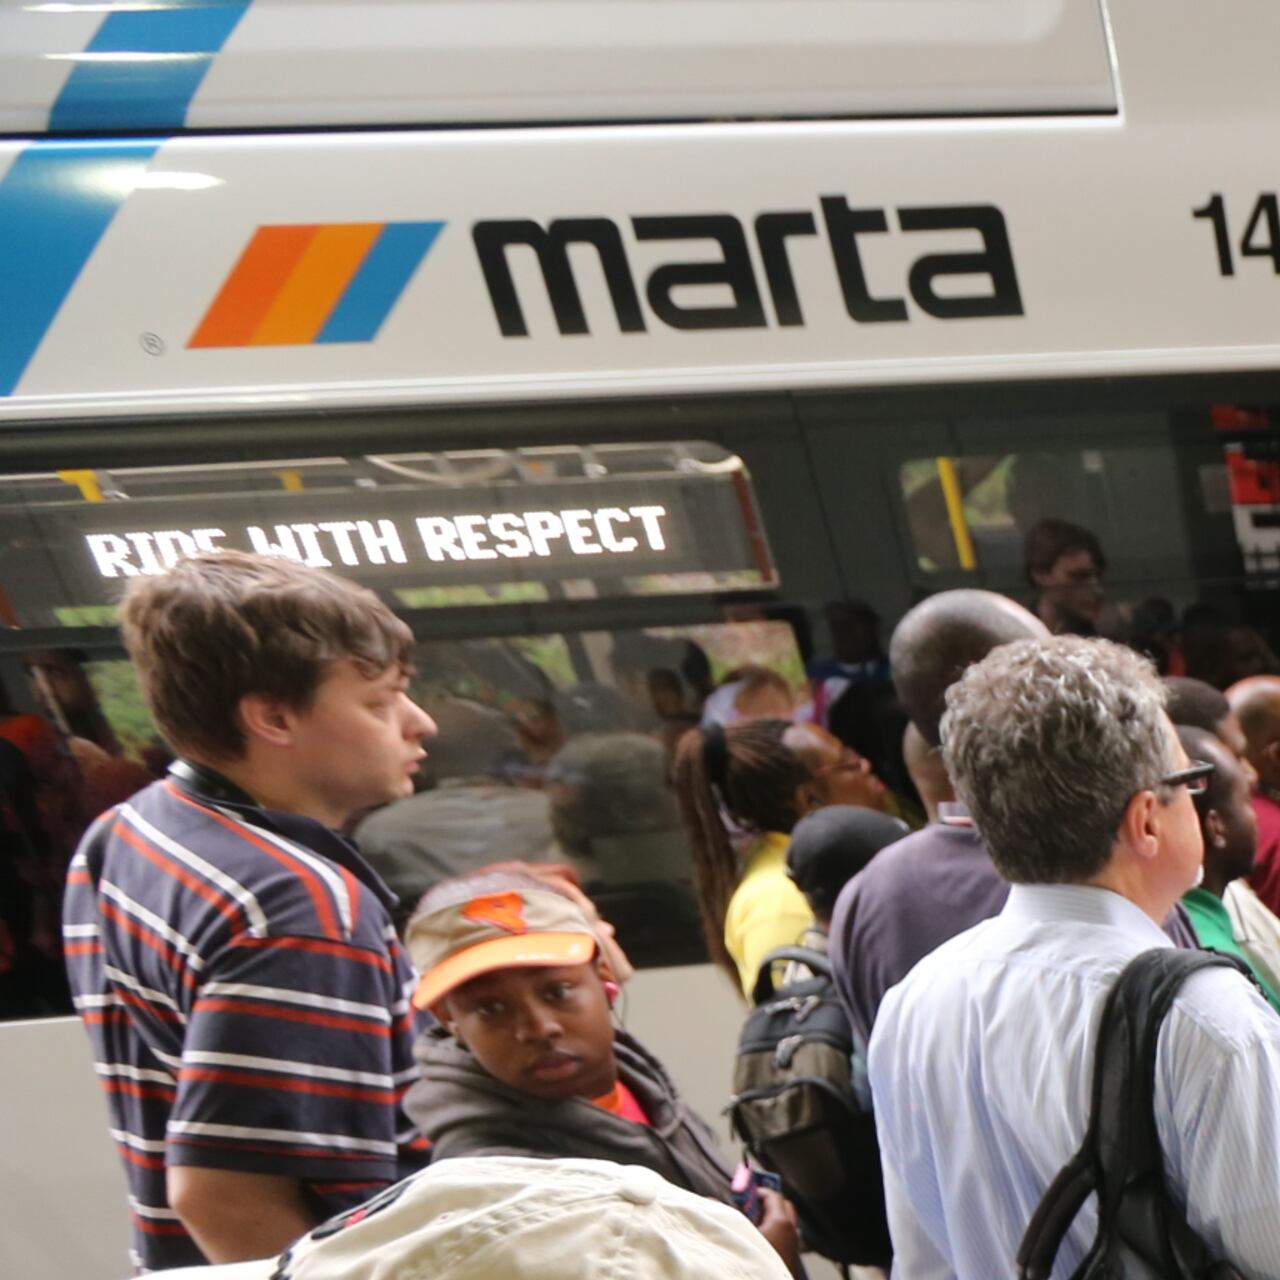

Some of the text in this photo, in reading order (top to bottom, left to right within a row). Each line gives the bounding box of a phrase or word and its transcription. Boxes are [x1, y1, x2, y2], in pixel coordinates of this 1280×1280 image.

[471, 195, 1025, 337] marta
[246, 519, 408, 567] WITH
[415, 506, 666, 562] RESPECT
